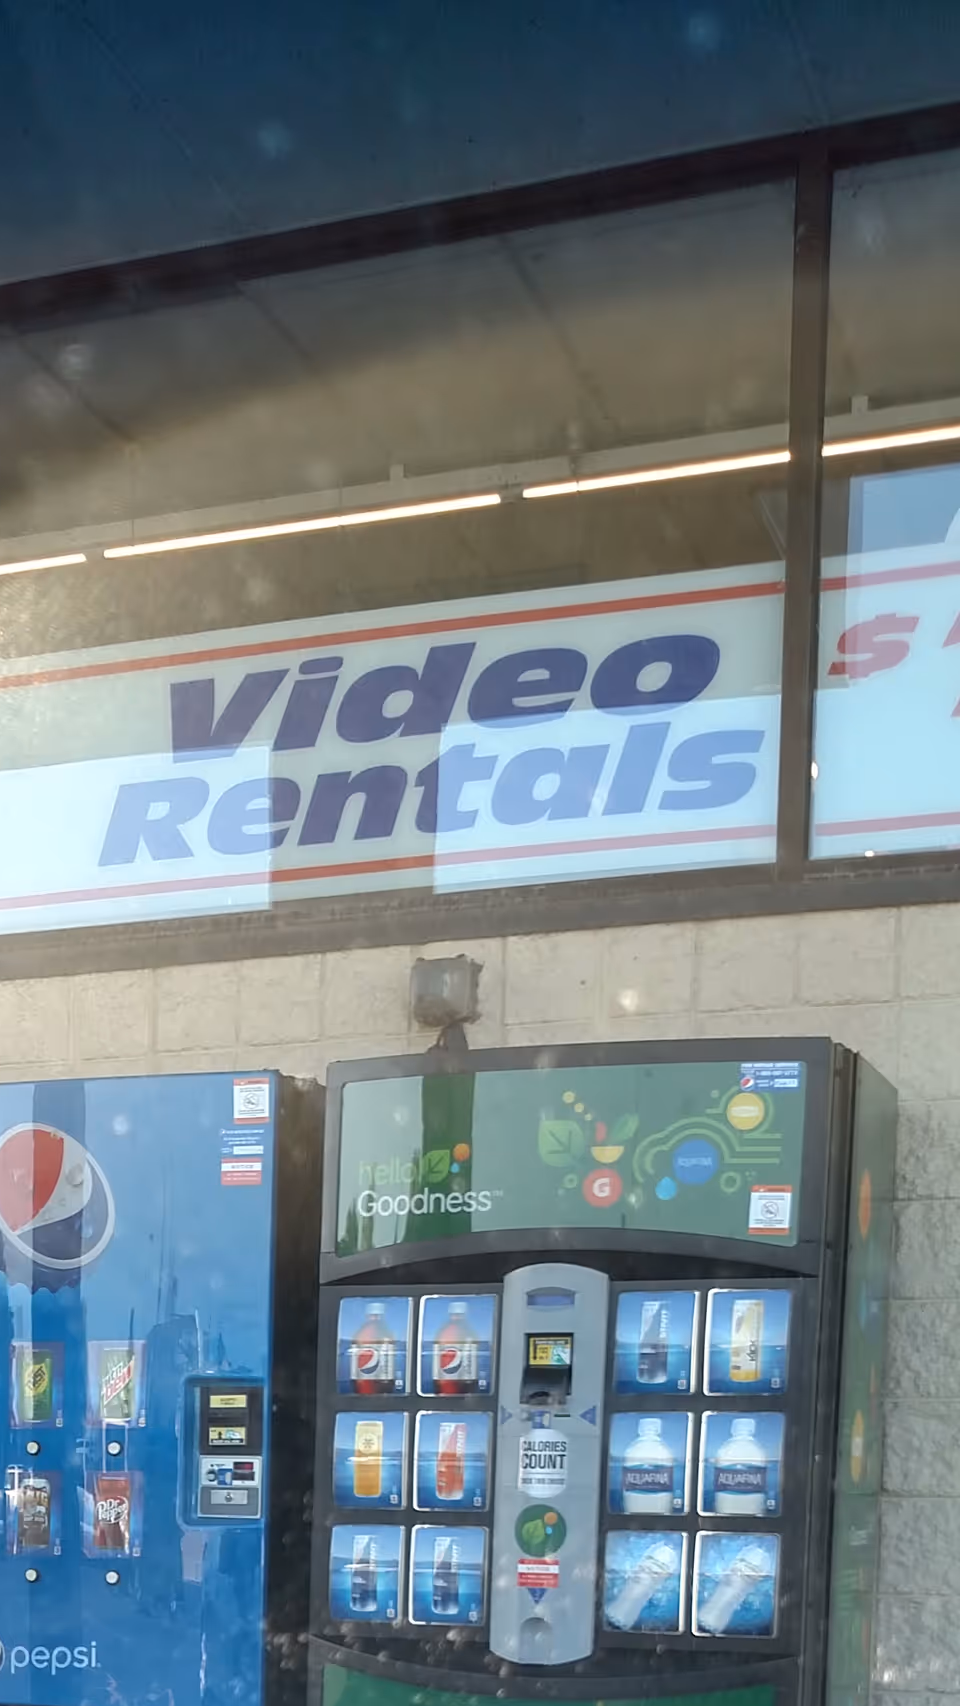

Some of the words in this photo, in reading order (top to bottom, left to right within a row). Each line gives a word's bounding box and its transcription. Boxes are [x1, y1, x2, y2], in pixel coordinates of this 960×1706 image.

[170, 633, 720, 763] Video
[97, 721, 765, 867] Rentals
[357, 1187, 492, 1217] Goodness
[522, 1440, 567, 1453] CALORIES
[522, 1453, 567, 1470] COUNT
[10, 1641, 97, 1675] pepsi
